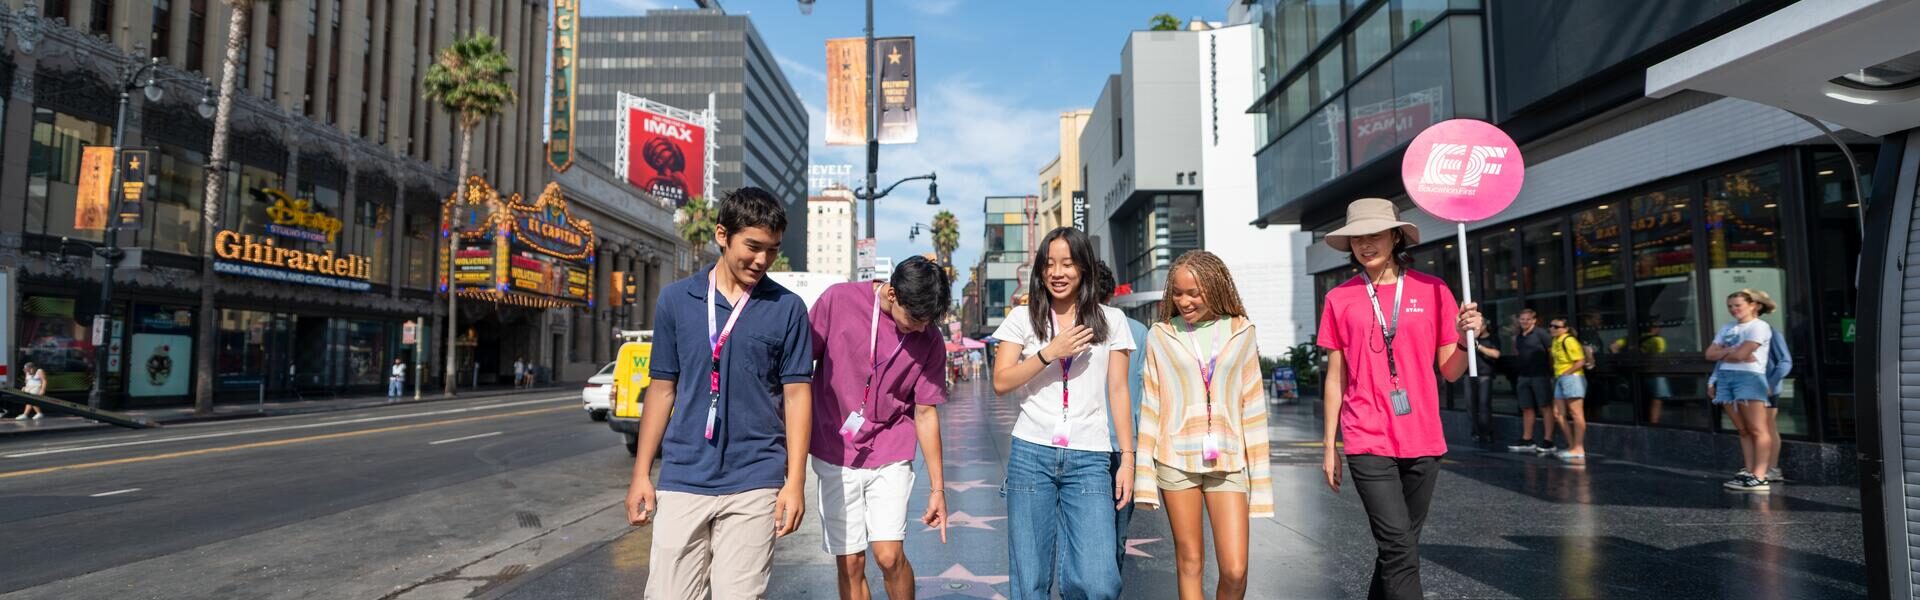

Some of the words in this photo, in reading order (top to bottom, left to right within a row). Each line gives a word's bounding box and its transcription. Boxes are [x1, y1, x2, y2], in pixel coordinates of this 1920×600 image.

[553, 15, 572, 153] CAPITAN
[643, 118, 693, 143] IMAX
[808, 164, 853, 175] EVELT
[1420, 143, 1508, 187] EF
[529, 218, 540, 233] EL
[541, 224, 583, 247] CAPITAN
[215, 229, 373, 280] Ghirardelli
[213, 261, 241, 273] SODA
[241, 265, 286, 281] FOUNTAIN
[287, 271, 305, 282] AND
